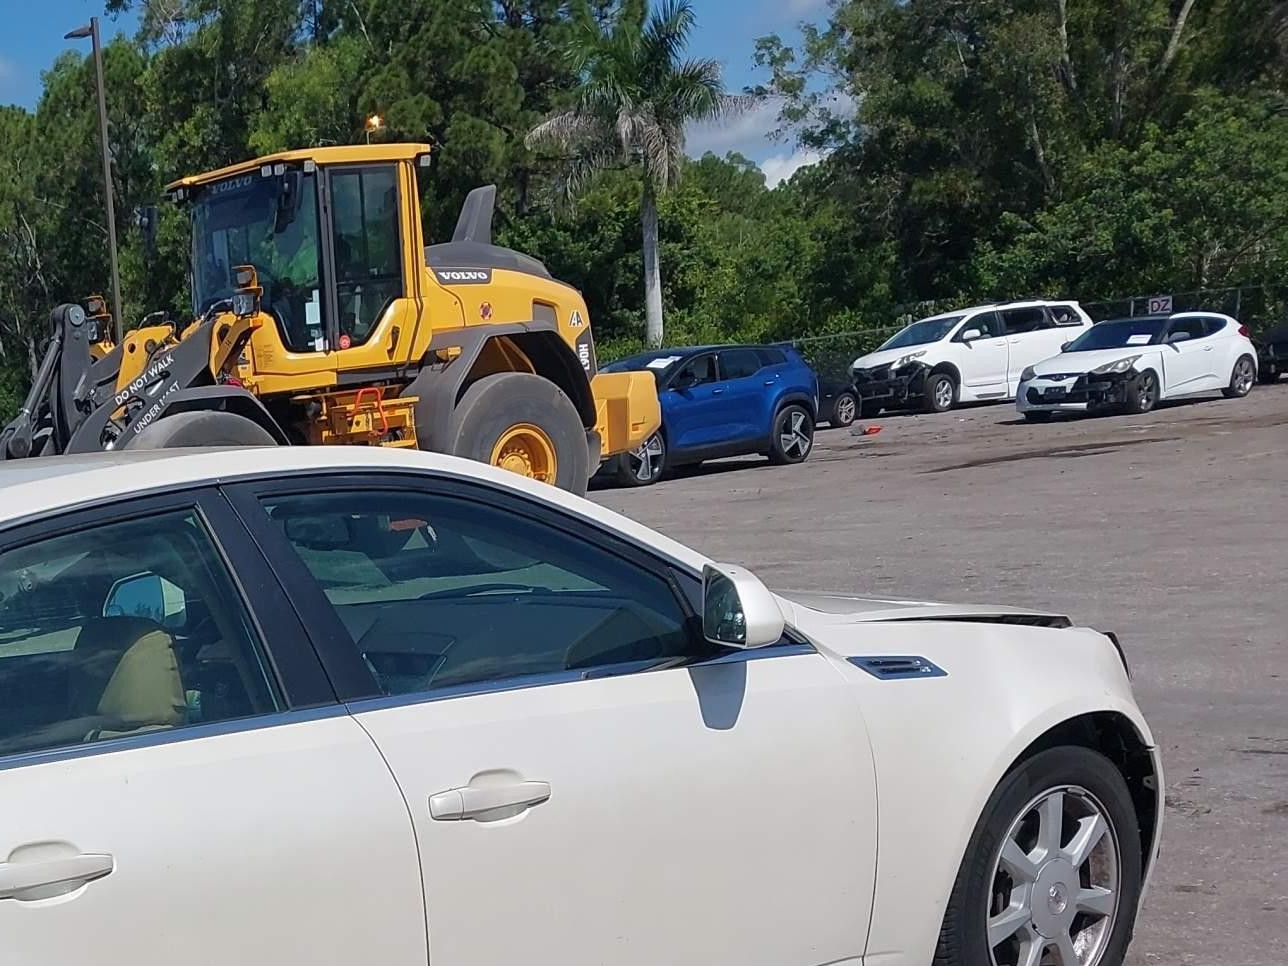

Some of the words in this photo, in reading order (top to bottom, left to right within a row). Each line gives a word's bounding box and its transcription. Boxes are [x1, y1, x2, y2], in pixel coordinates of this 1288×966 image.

[212, 176, 252, 194] VOLVO
[438, 271, 488, 280] VOLVO
[1152, 299, 1170, 312] DZ
[115, 390, 129, 405] DO
[129, 374, 149, 394] NOT
[148, 353, 174, 377] WALK
[133, 404, 161, 434] UNDER
